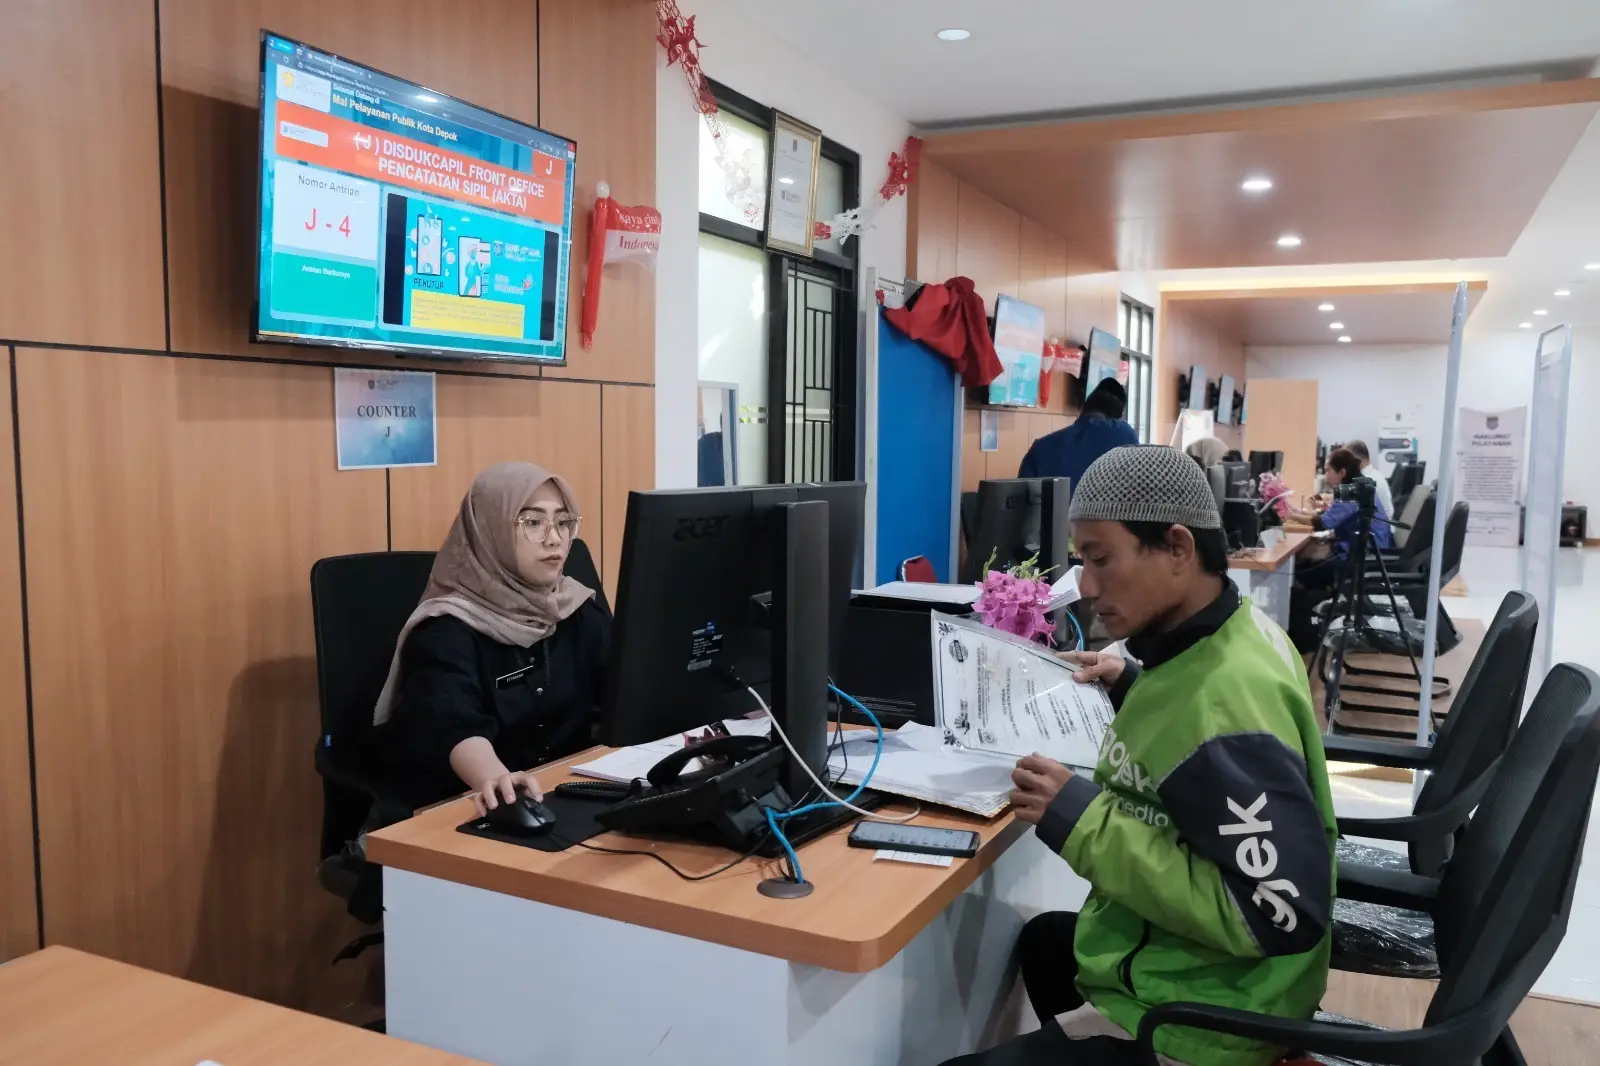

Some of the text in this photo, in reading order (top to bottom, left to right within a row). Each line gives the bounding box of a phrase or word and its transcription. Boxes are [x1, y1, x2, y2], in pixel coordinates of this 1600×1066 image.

[332, 94, 458, 141] Mal Pelayanan Publik Kota Depok
[383, 139, 466, 177] DISDUKCAPIL
[469, 164, 506, 187] FRONT
[508, 176, 545, 198] OFFICE
[298, 174, 360, 197] Nomor Antrian
[378, 157, 527, 212] PENCATATAN SIPIL (AKTA)
[357, 405, 416, 418] COUNTER
[385, 426, 391, 438] J
[672, 514, 731, 543] acer
